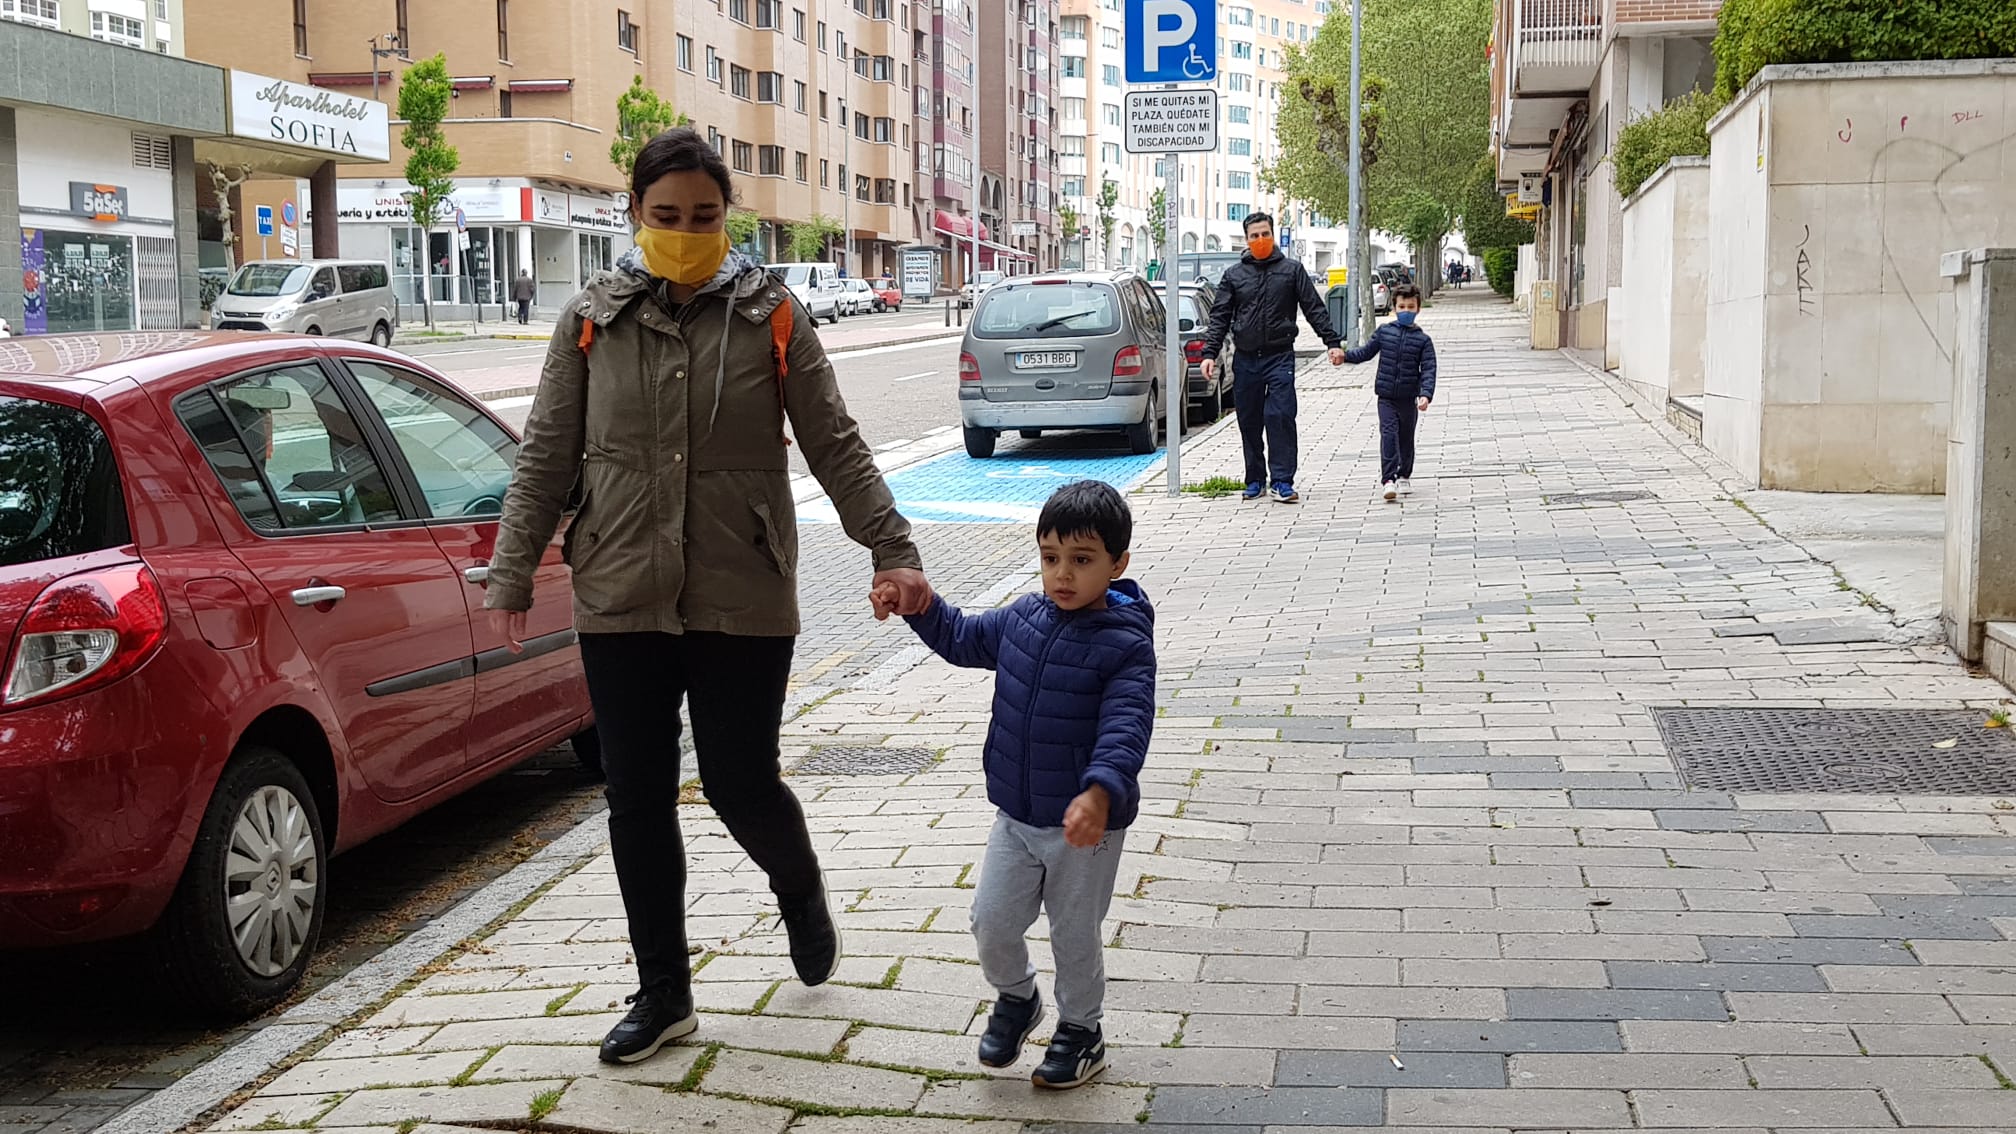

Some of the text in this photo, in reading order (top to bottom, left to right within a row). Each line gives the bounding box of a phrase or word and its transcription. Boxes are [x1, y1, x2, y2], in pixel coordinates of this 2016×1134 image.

[1143, 0, 1197, 72] P
[255, 80, 368, 121] Aparthotel
[1132, 95, 1210, 107] SI ME QUITAS MI
[1166, 108, 1210, 119] QUÉDATE
[270, 115, 357, 153] SOFIA
[1132, 122, 1210, 134] TAMBIÉN CON MI
[1137, 135, 1205, 147] DISCAPACIDAD
[365, 209, 372, 220] y
[1023, 352, 1072, 365] 0531 BBG
